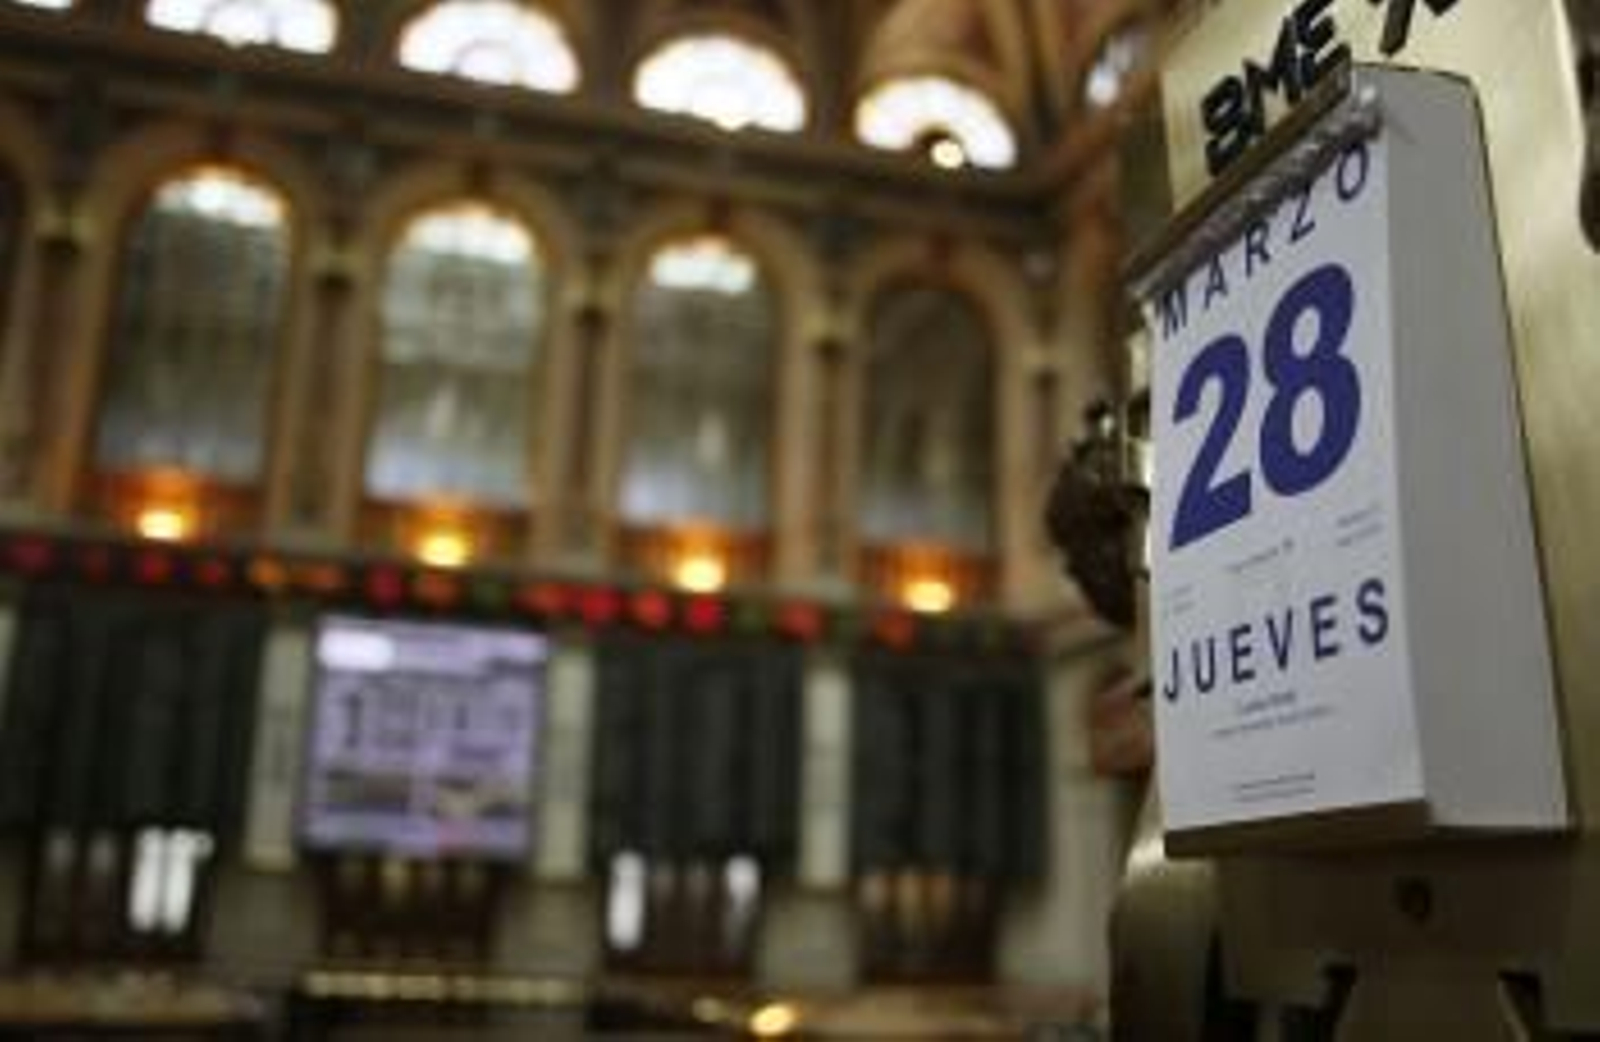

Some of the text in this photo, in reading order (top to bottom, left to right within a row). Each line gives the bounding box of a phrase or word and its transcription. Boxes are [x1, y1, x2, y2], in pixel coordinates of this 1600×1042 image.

[1201, 0, 1351, 177] BME
[1156, 142, 1370, 341] MARZO
[1169, 263, 1361, 552] 28
[1163, 578, 1389, 704] JUEVES
